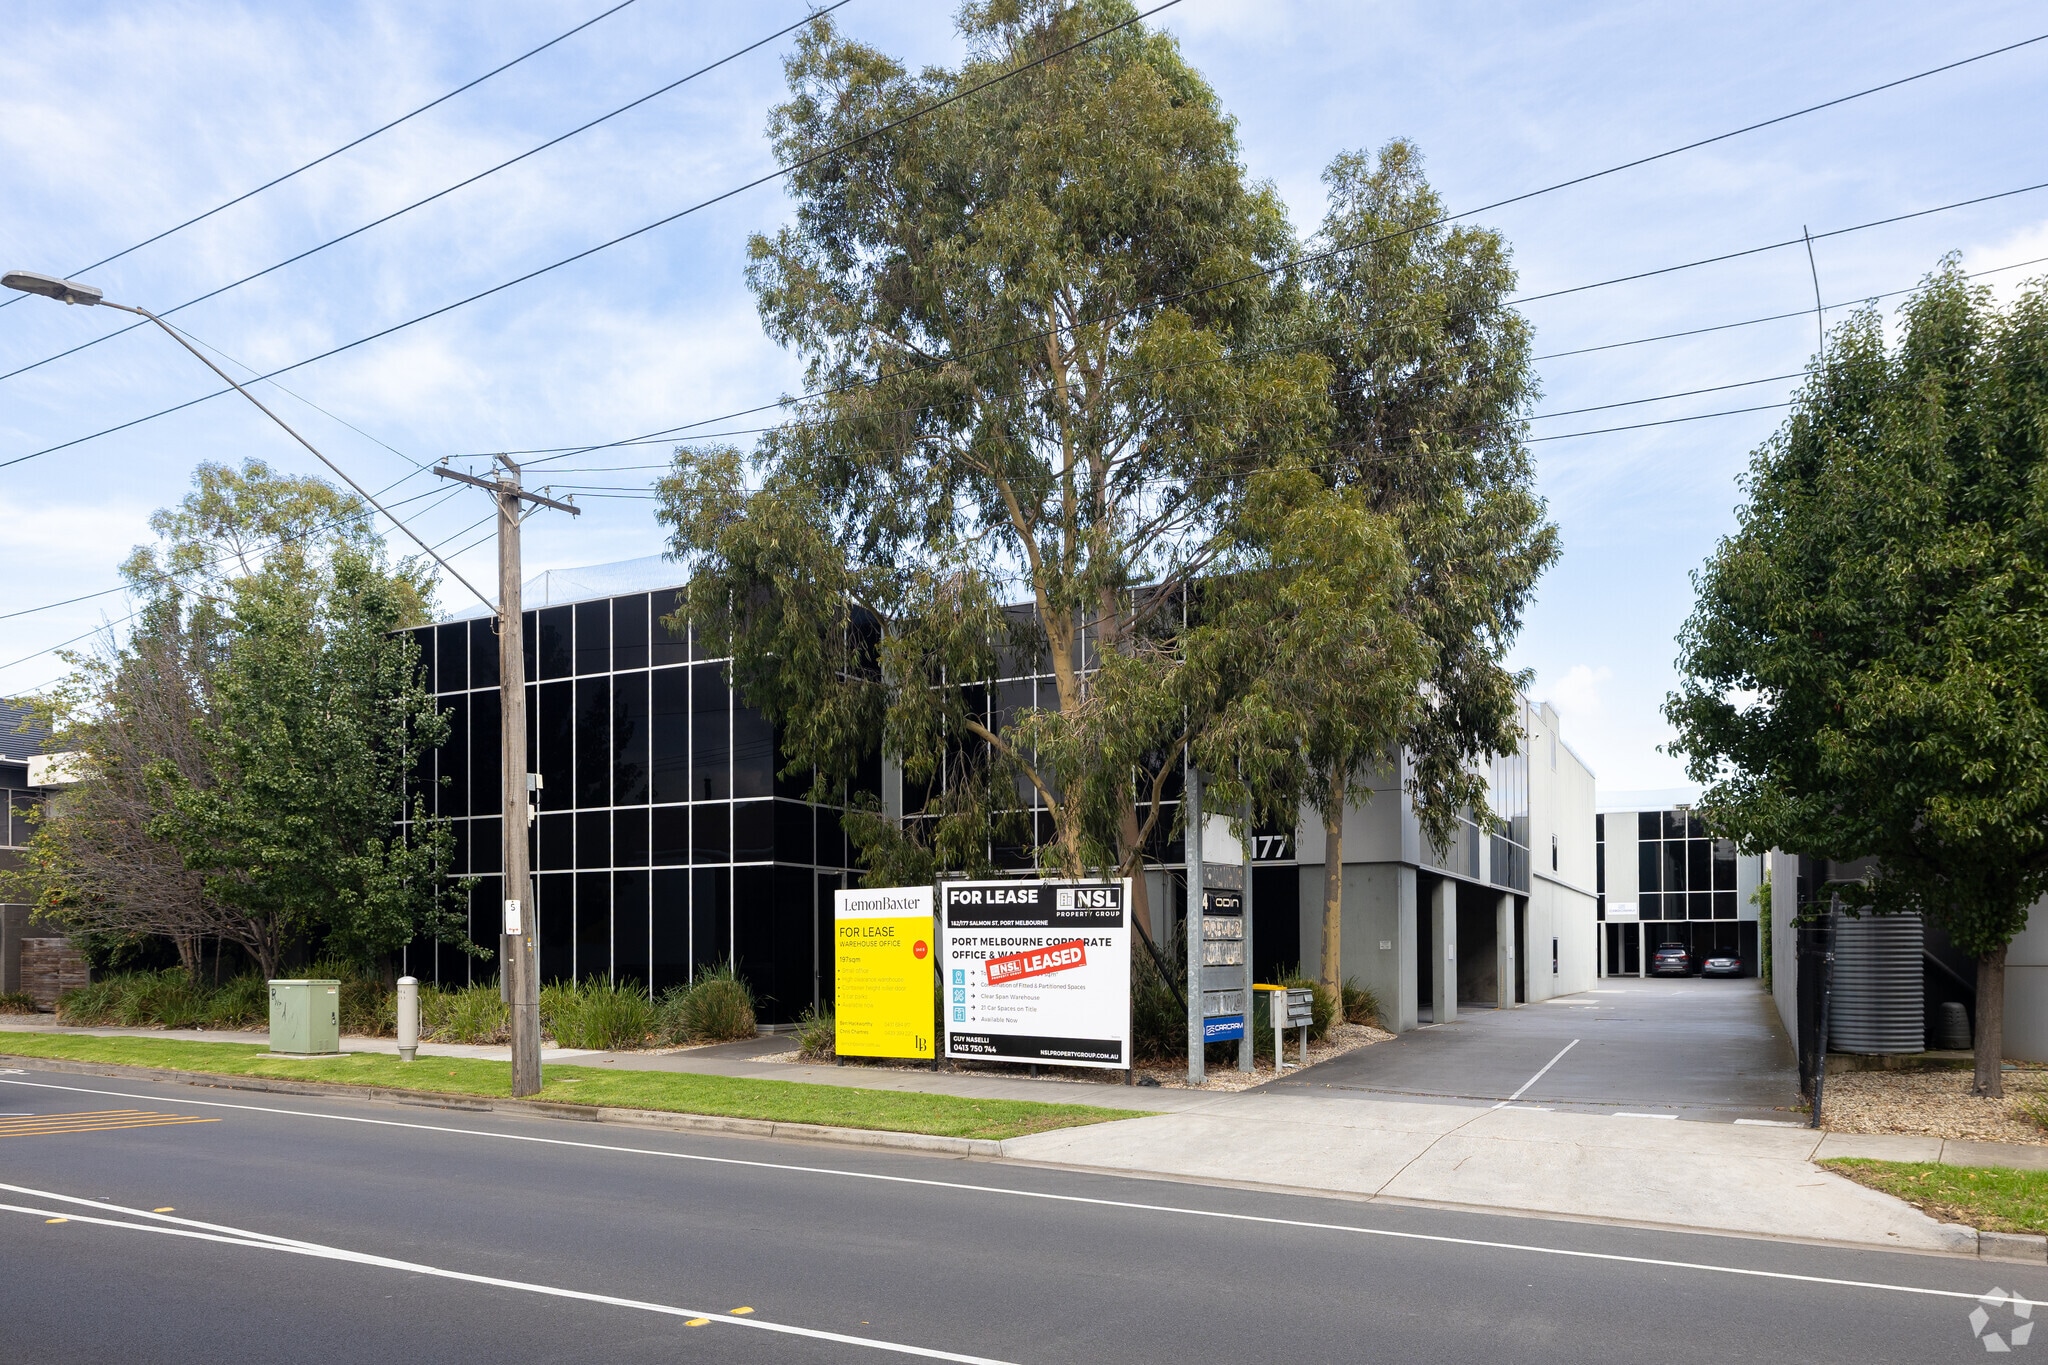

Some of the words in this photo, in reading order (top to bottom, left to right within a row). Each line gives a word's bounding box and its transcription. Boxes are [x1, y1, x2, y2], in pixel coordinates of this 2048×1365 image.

[1252, 835, 1287, 858] 177
[950, 891, 981, 904] FOR
[986, 889, 1038, 904] LEASE
[1078, 890, 1116, 907] NSL
[844, 897, 920, 911] LemonBaxter
[840, 927, 859, 937] FOR
[863, 926, 894, 937] LEASE
[952, 937, 977, 946] PORT
[980, 937, 1043, 946] MELBOURNE
[1046, 938, 1111, 947] CORPRATE
[952, 951, 986, 959] OFFICE
[989, 951, 994, 959] &
[1023, 947, 1082, 972] LEASED
[1000, 961, 1019, 973] NSL
[1215, 1022, 1243, 1031] CARCRAM
[984, 1045, 996, 1053] 744
[1040, 1050, 1119, 1059] NSLPROPERTYGROUP.COM.AU
